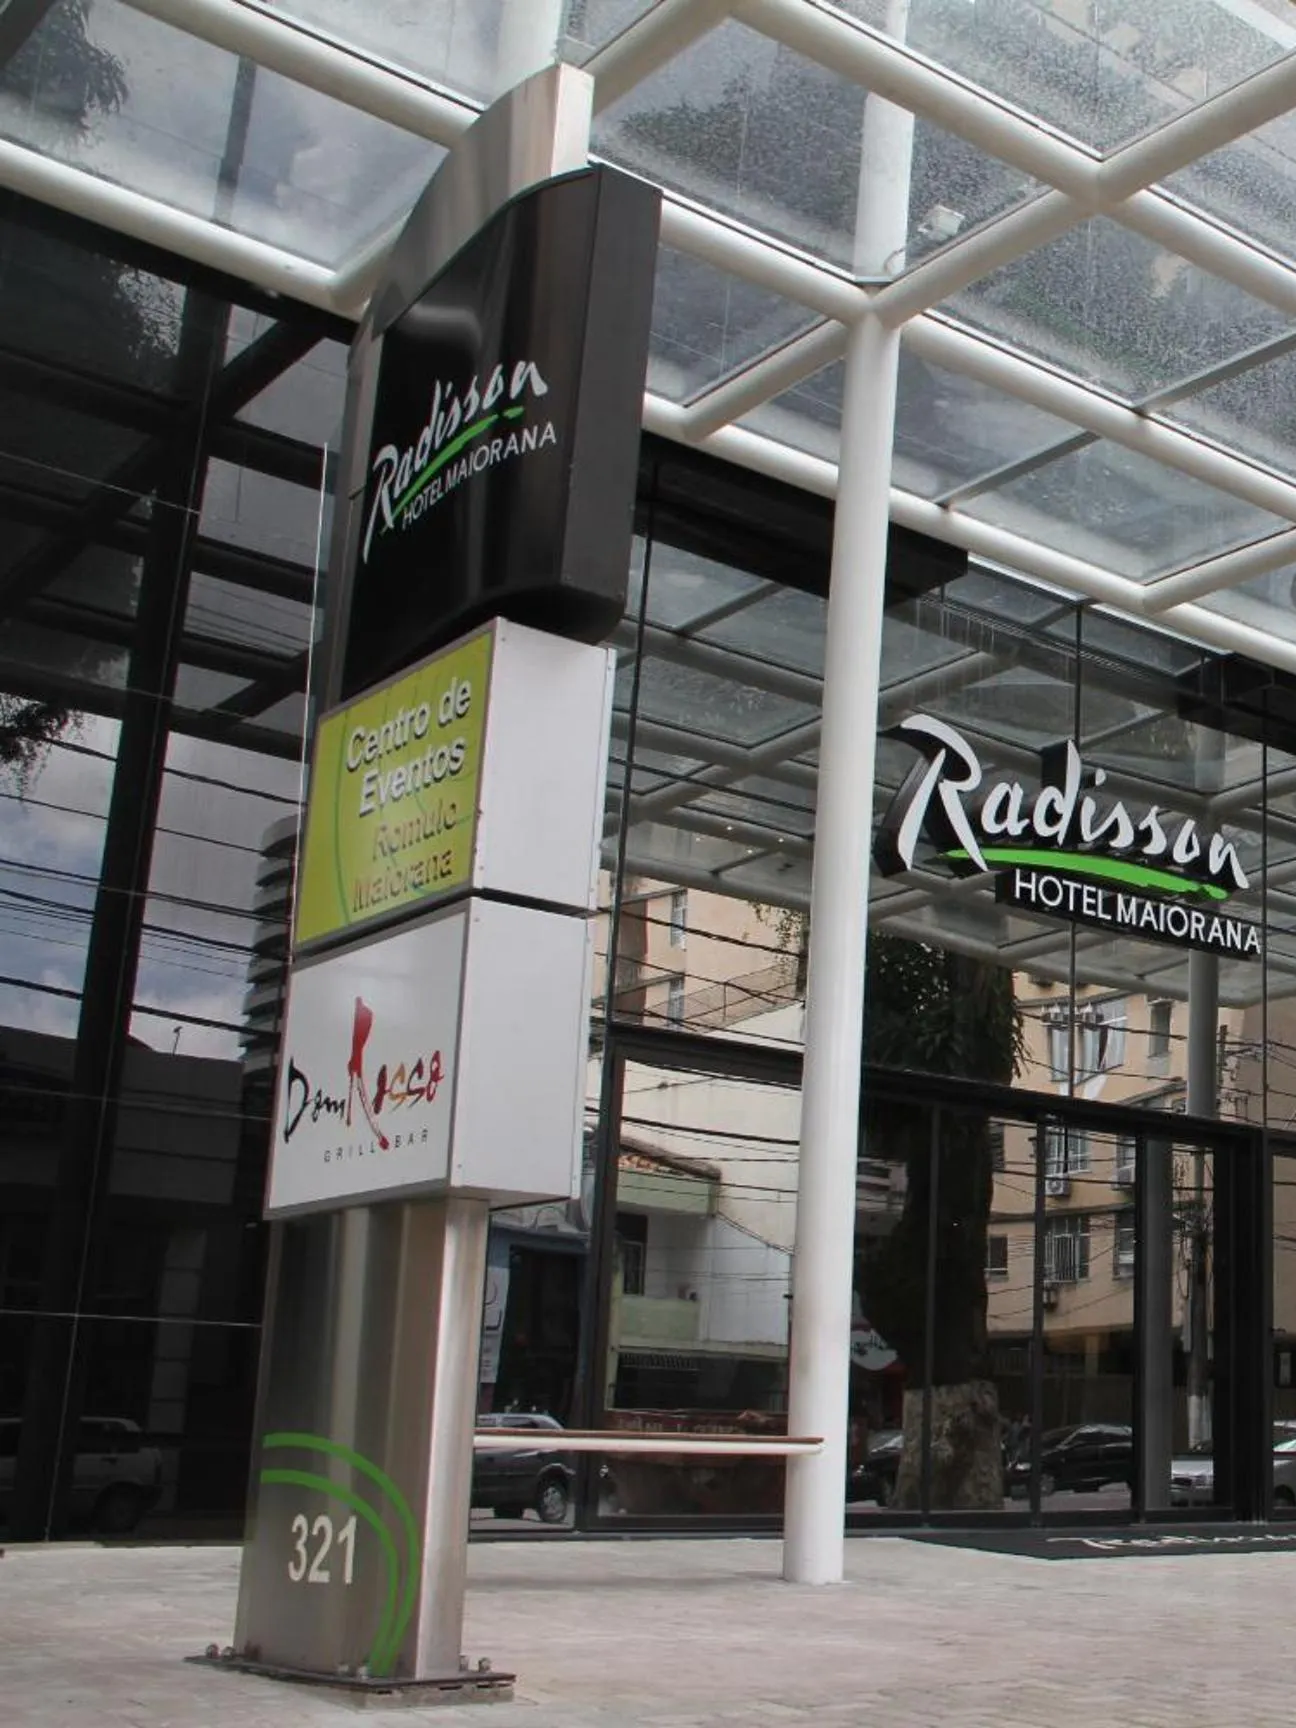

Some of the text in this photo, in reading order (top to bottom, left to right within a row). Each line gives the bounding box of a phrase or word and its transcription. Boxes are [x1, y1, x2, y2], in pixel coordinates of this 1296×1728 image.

[362, 360, 548, 564] Radisson
[401, 421, 557, 530] HOTEL MAIORANA
[347, 677, 471, 773] Centro de
[359, 738, 466, 818] Eventos
[897, 713, 1250, 889] Radisson
[1014, 868, 1261, 954] HOTEL MAIORANA
[288, 1513, 357, 1584] 321
